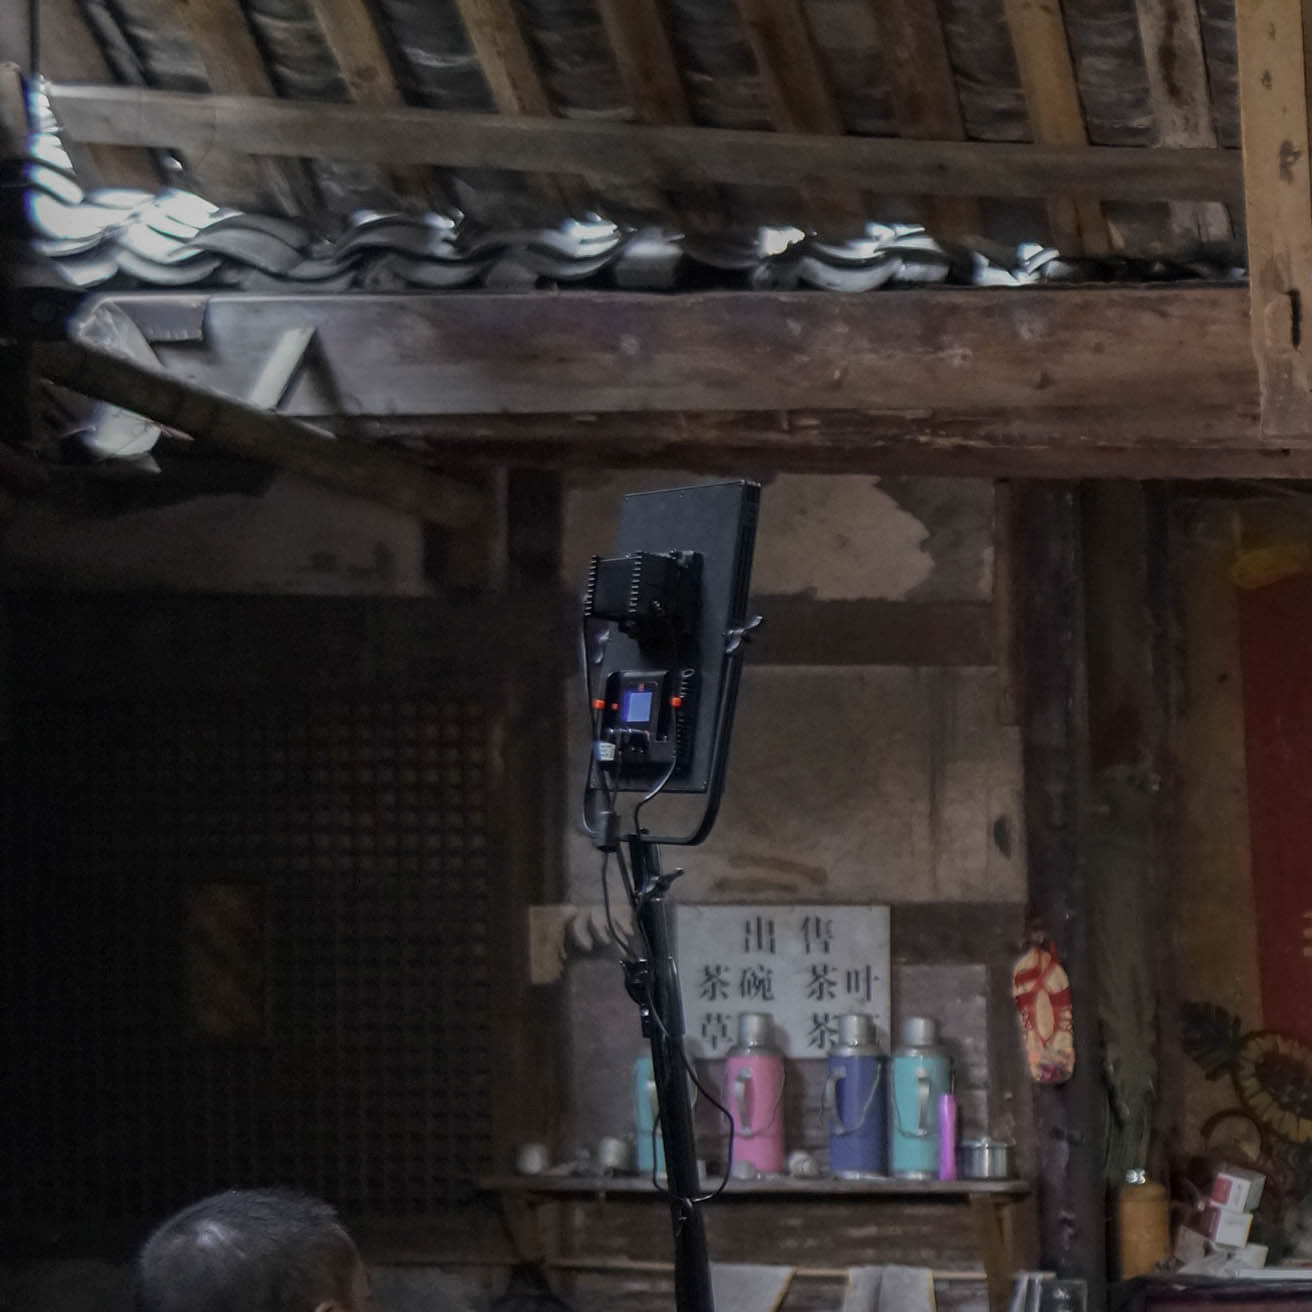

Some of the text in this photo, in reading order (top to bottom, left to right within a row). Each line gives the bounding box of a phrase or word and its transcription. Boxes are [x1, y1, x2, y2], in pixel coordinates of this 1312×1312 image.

[742, 914, 835, 955] 出售
[699, 963, 881, 1002] 茶碗 茶叶
